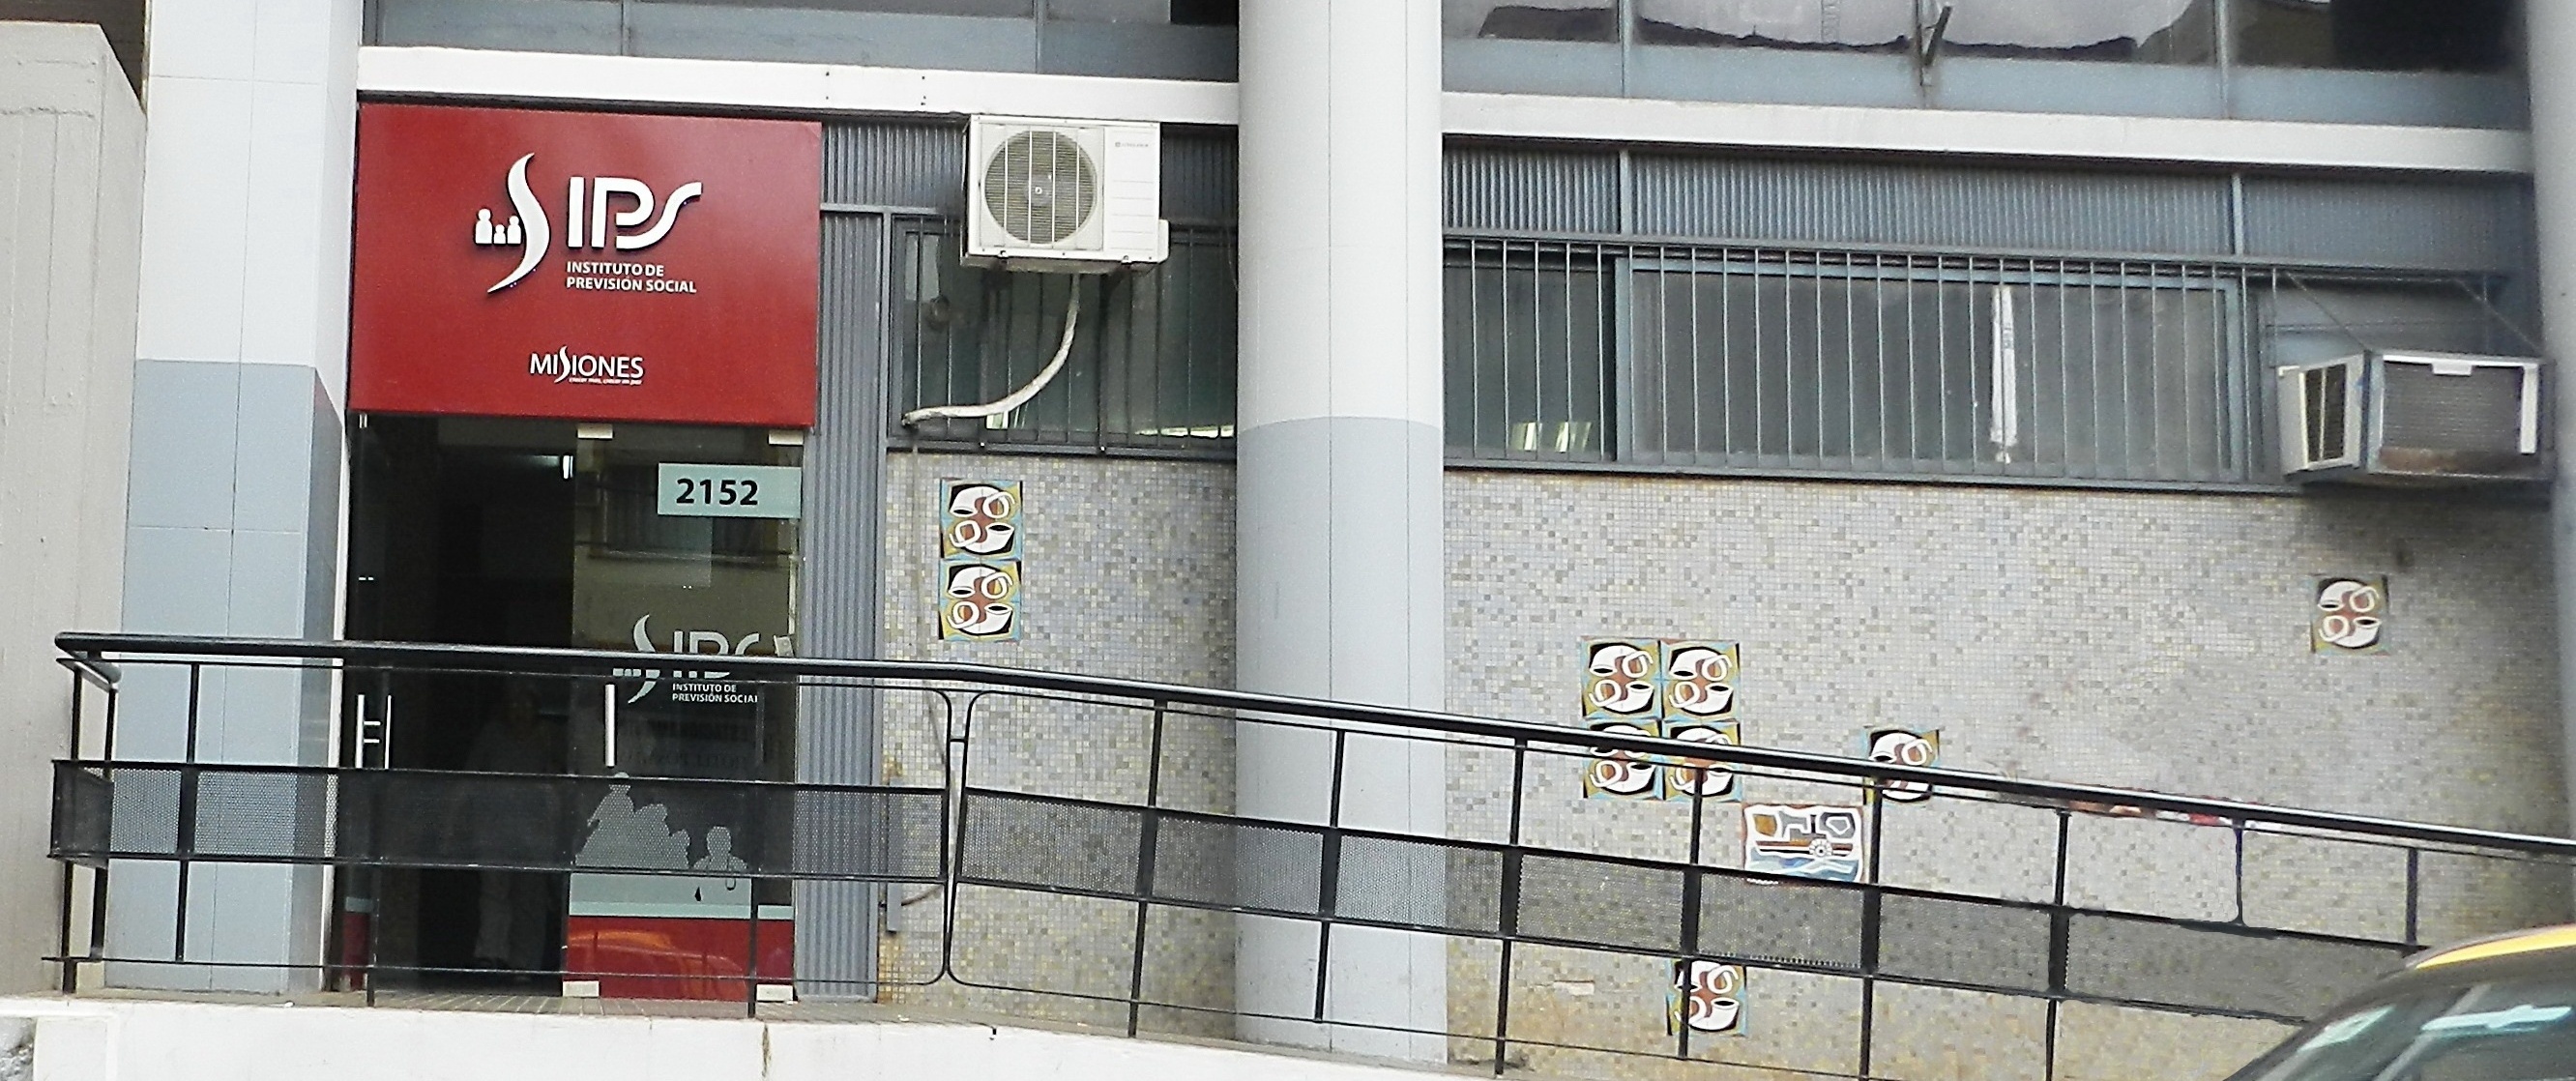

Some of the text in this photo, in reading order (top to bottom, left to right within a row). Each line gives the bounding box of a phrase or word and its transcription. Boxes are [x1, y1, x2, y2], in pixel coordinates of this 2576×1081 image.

[568, 177, 702, 248] IPS
[567, 261, 664, 277] INSTITUTO DE
[567, 275, 696, 293] PREVISIÓN SOCIAL
[530, 346, 644, 383] MISIONES
[676, 479, 759, 506] 2152
[672, 683, 737, 693] INSTITUTO DE
